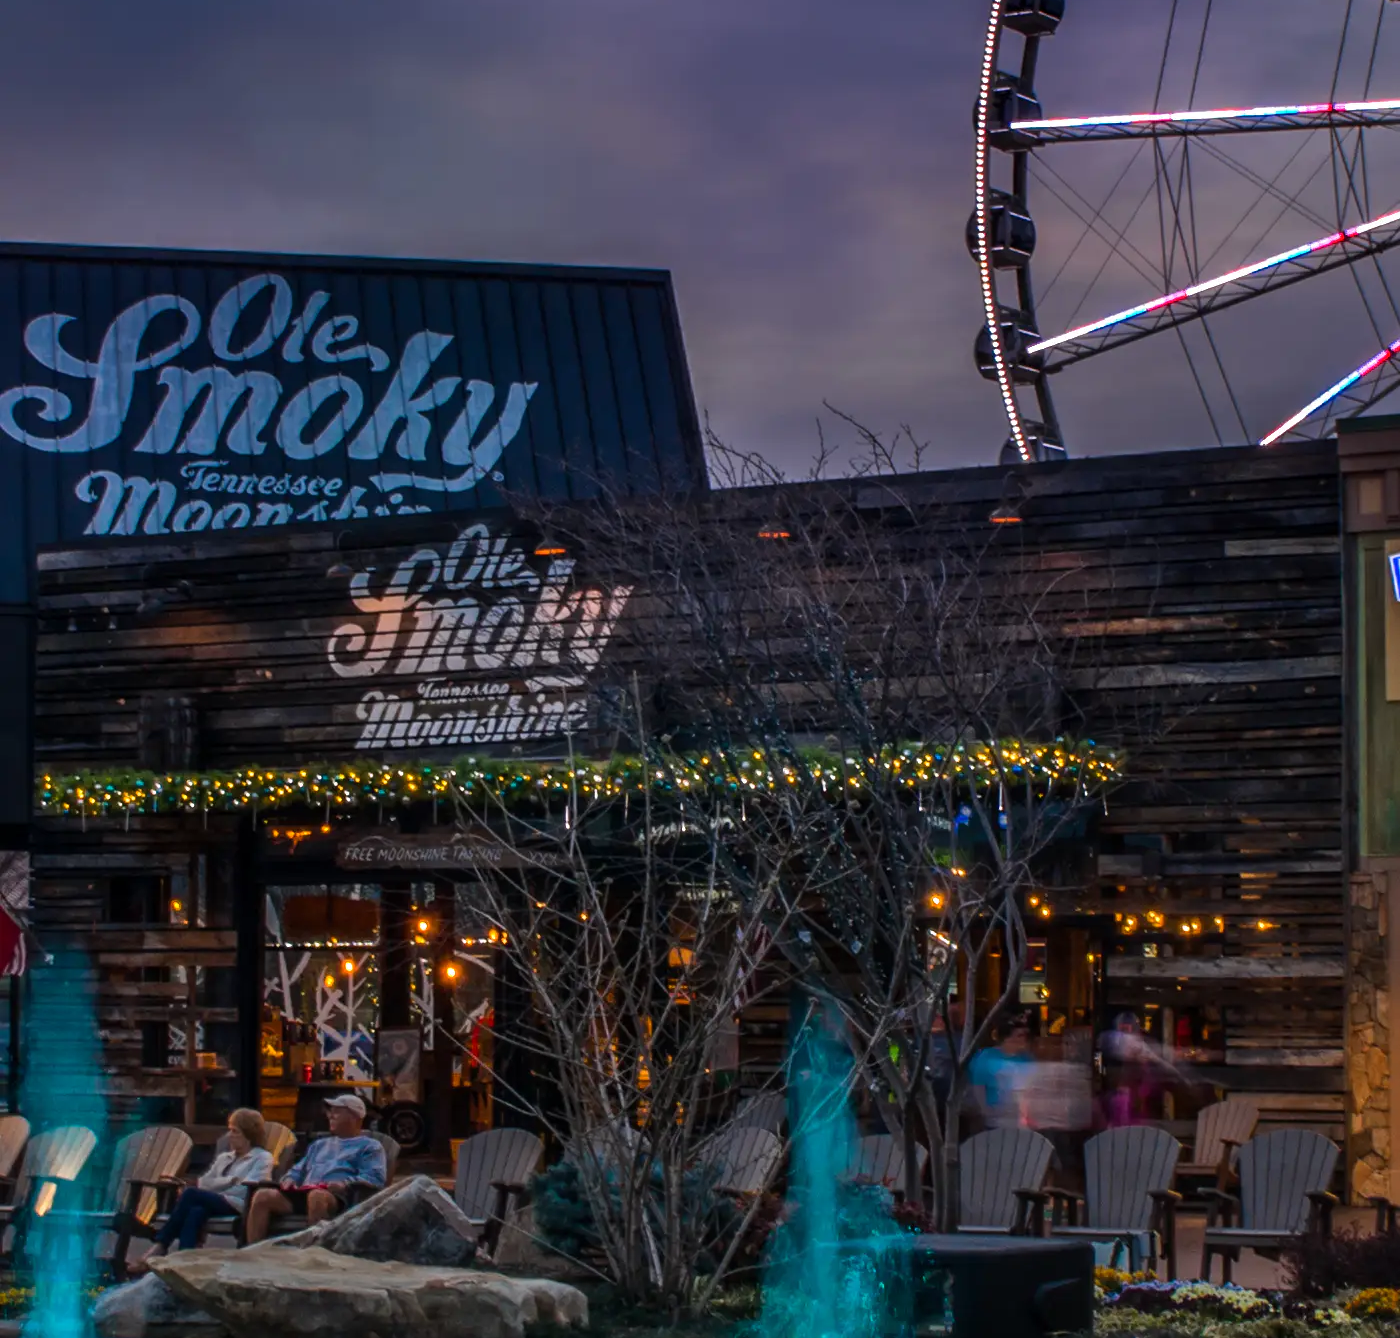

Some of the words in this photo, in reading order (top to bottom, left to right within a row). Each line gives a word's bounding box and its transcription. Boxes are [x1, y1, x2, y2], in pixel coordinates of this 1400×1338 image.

[207, 272, 390, 372] Ole
[0, 293, 539, 493] Smoky
[180, 460, 344, 498] Tennessee
[443, 522, 541, 594] Ole
[327, 548, 635, 694] Smoky
[353, 690, 589, 751] Moonshine
[416, 676, 511, 705] Tennessee
[344, 847, 375, 862] FREE
[377, 846, 450, 862] MOONSHINE
